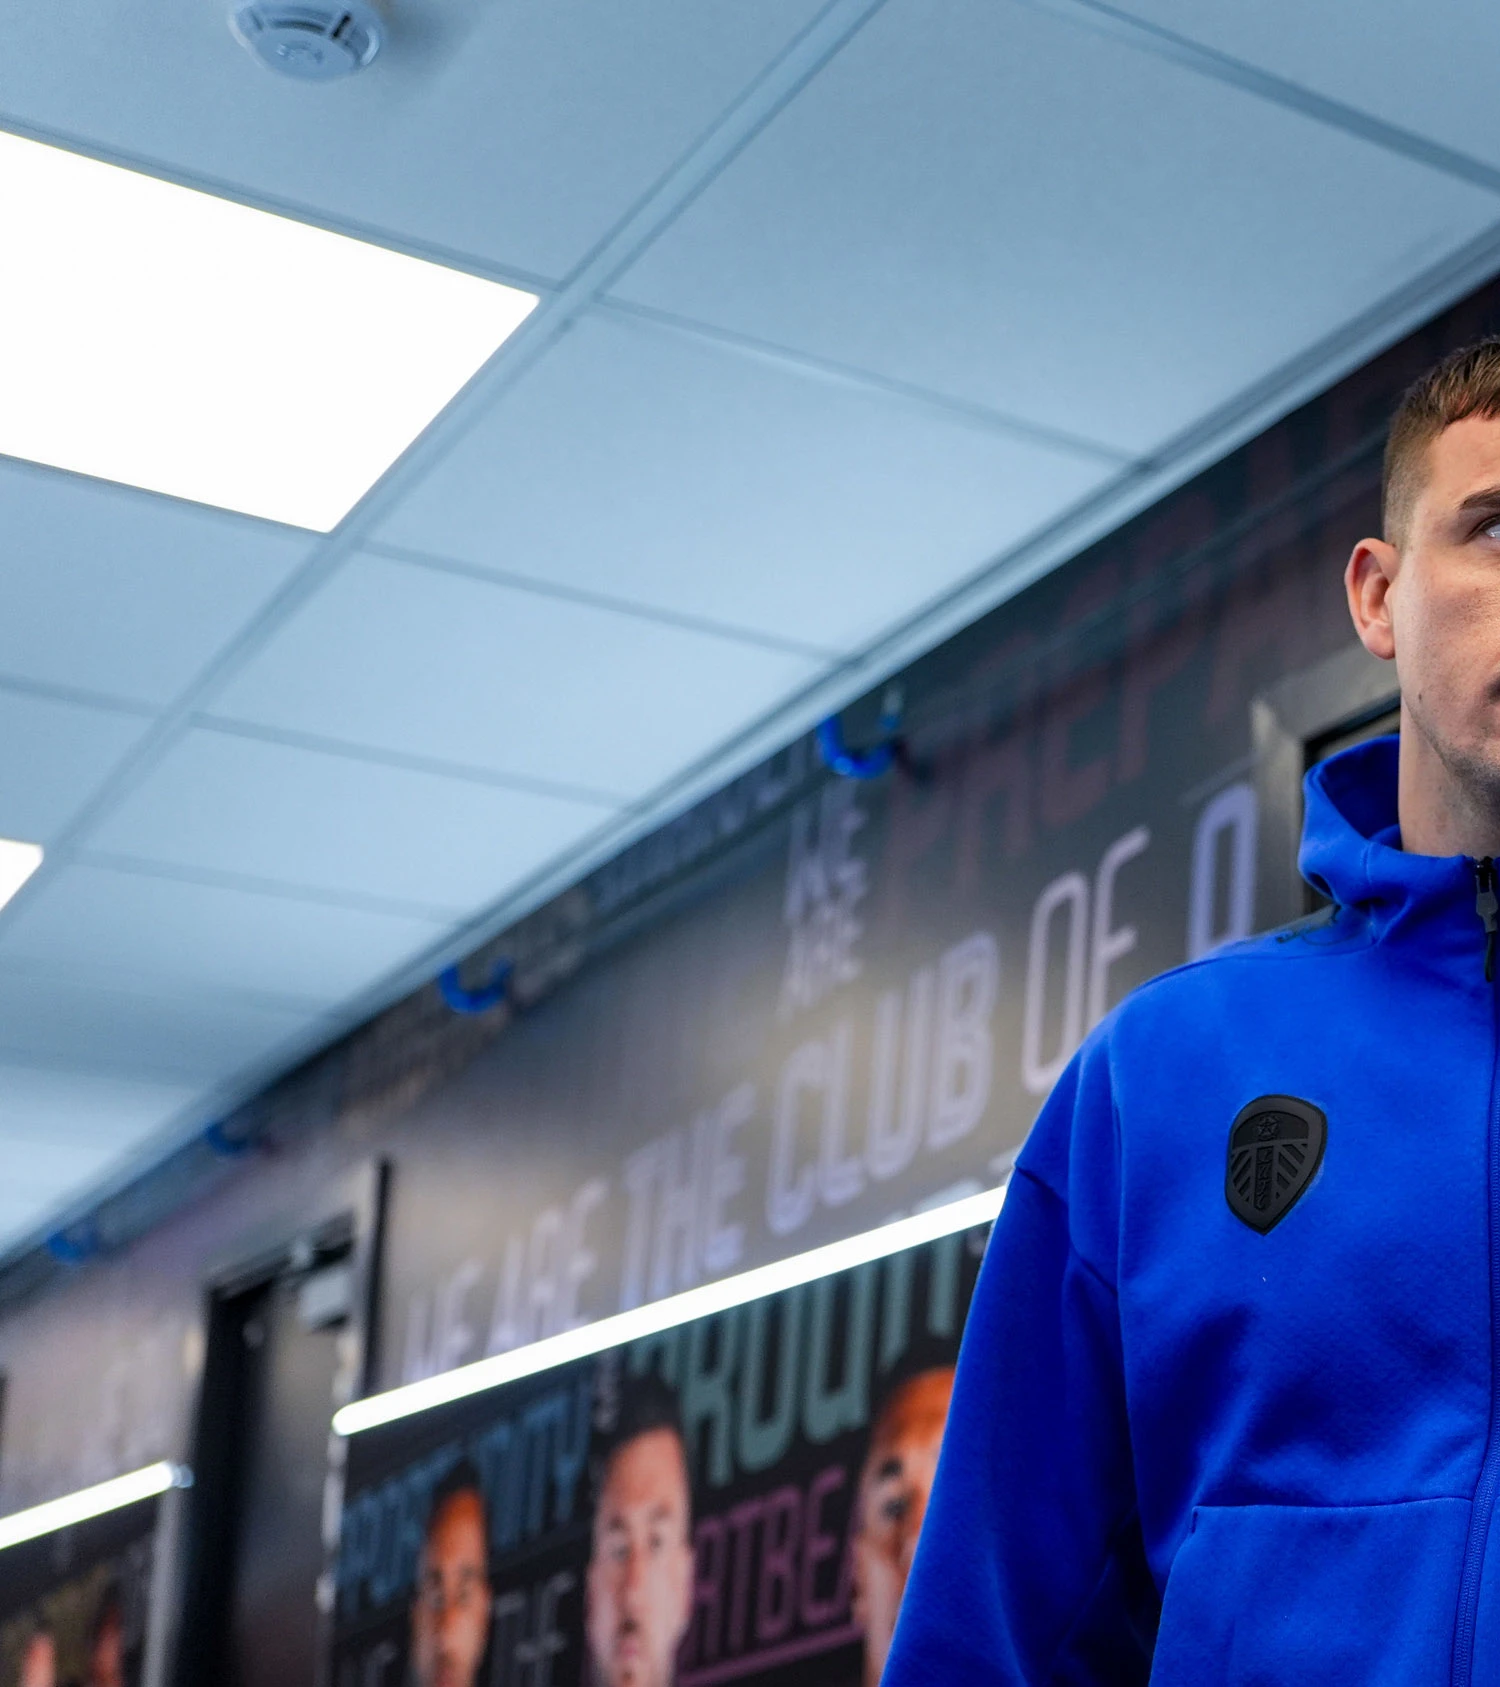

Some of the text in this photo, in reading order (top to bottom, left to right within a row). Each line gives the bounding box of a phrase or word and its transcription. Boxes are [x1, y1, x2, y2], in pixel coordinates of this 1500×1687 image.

[618, 1082, 757, 1313] THE
[766, 930, 1000, 1236] CLUB
[1022, 822, 1152, 1092] OF
